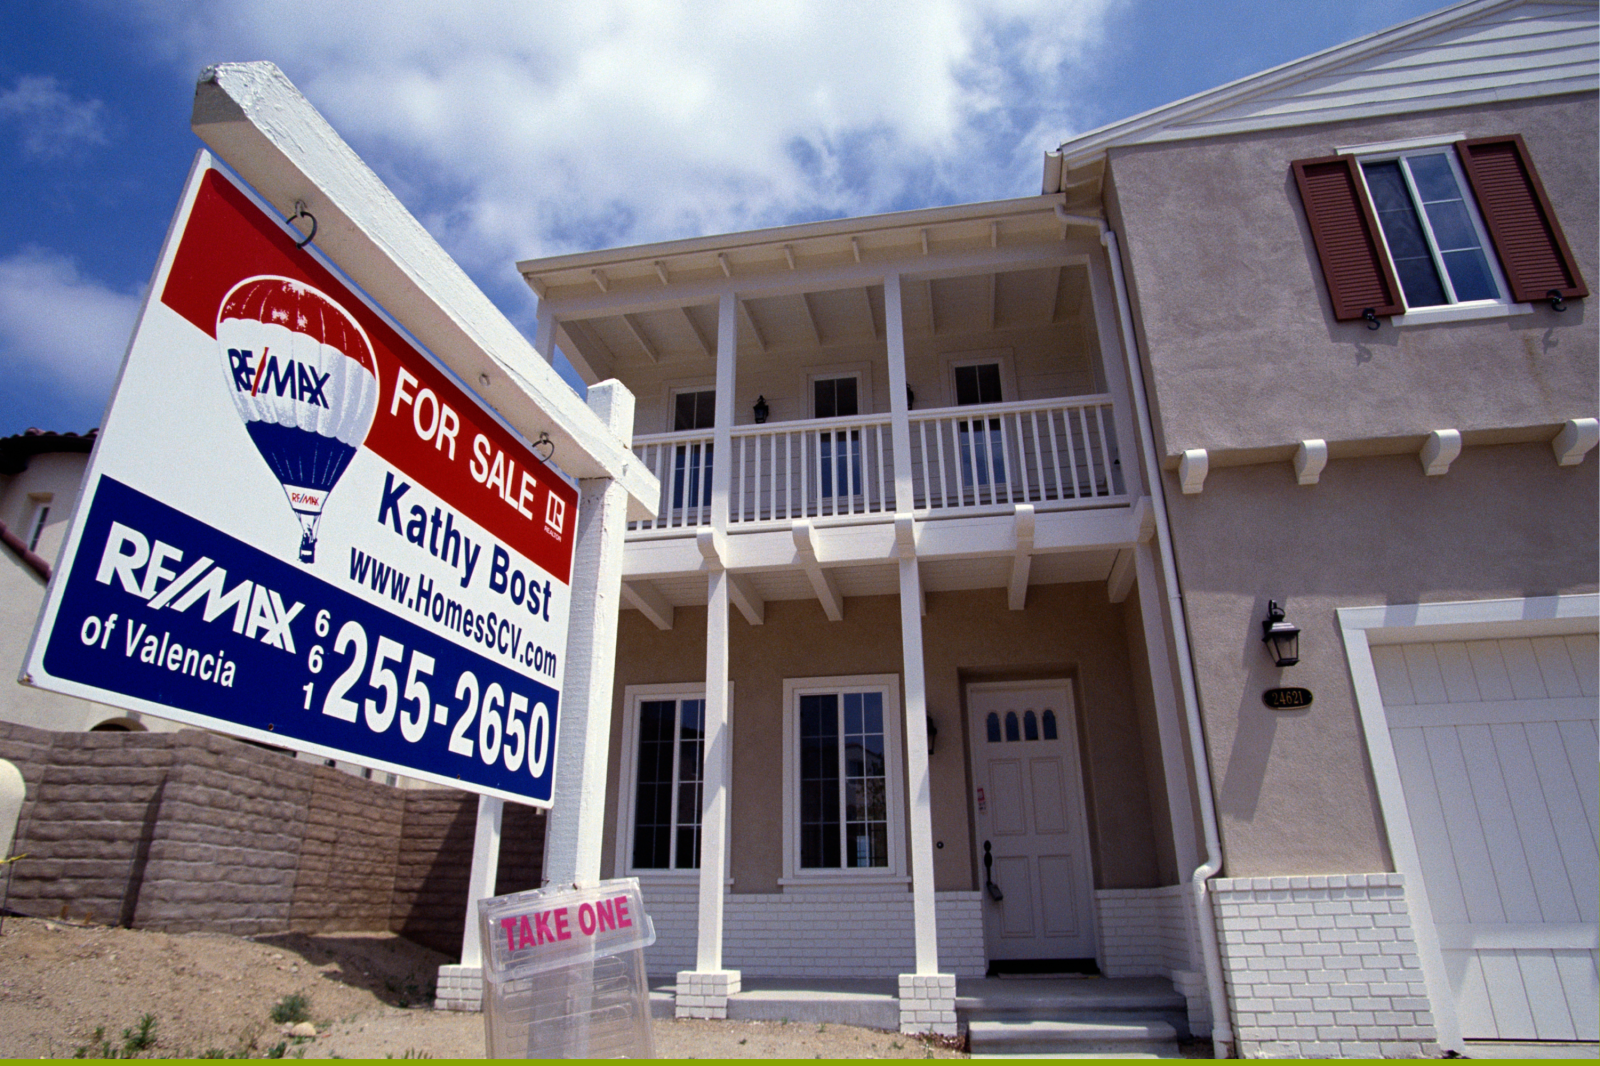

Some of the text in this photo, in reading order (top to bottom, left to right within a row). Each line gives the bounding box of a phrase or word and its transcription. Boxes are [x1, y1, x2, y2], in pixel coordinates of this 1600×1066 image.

[227, 346, 331, 410] RE/MAX
[390, 366, 537, 521] FOR SALE
[291, 492, 319, 506] RE/MAX
[544, 525, 562, 543] REALTOR
[377, 470, 552, 622] Kathy Bost
[95, 520, 306, 655] RE/MAX
[350, 546, 557, 679] www.HomesSCV.com
[80, 613, 236, 688] of Valencia
[322, 620, 550, 779] 255-2650
[1271, 690, 1304, 705] 24621
[501, 895, 633, 951] TAKE ONE
